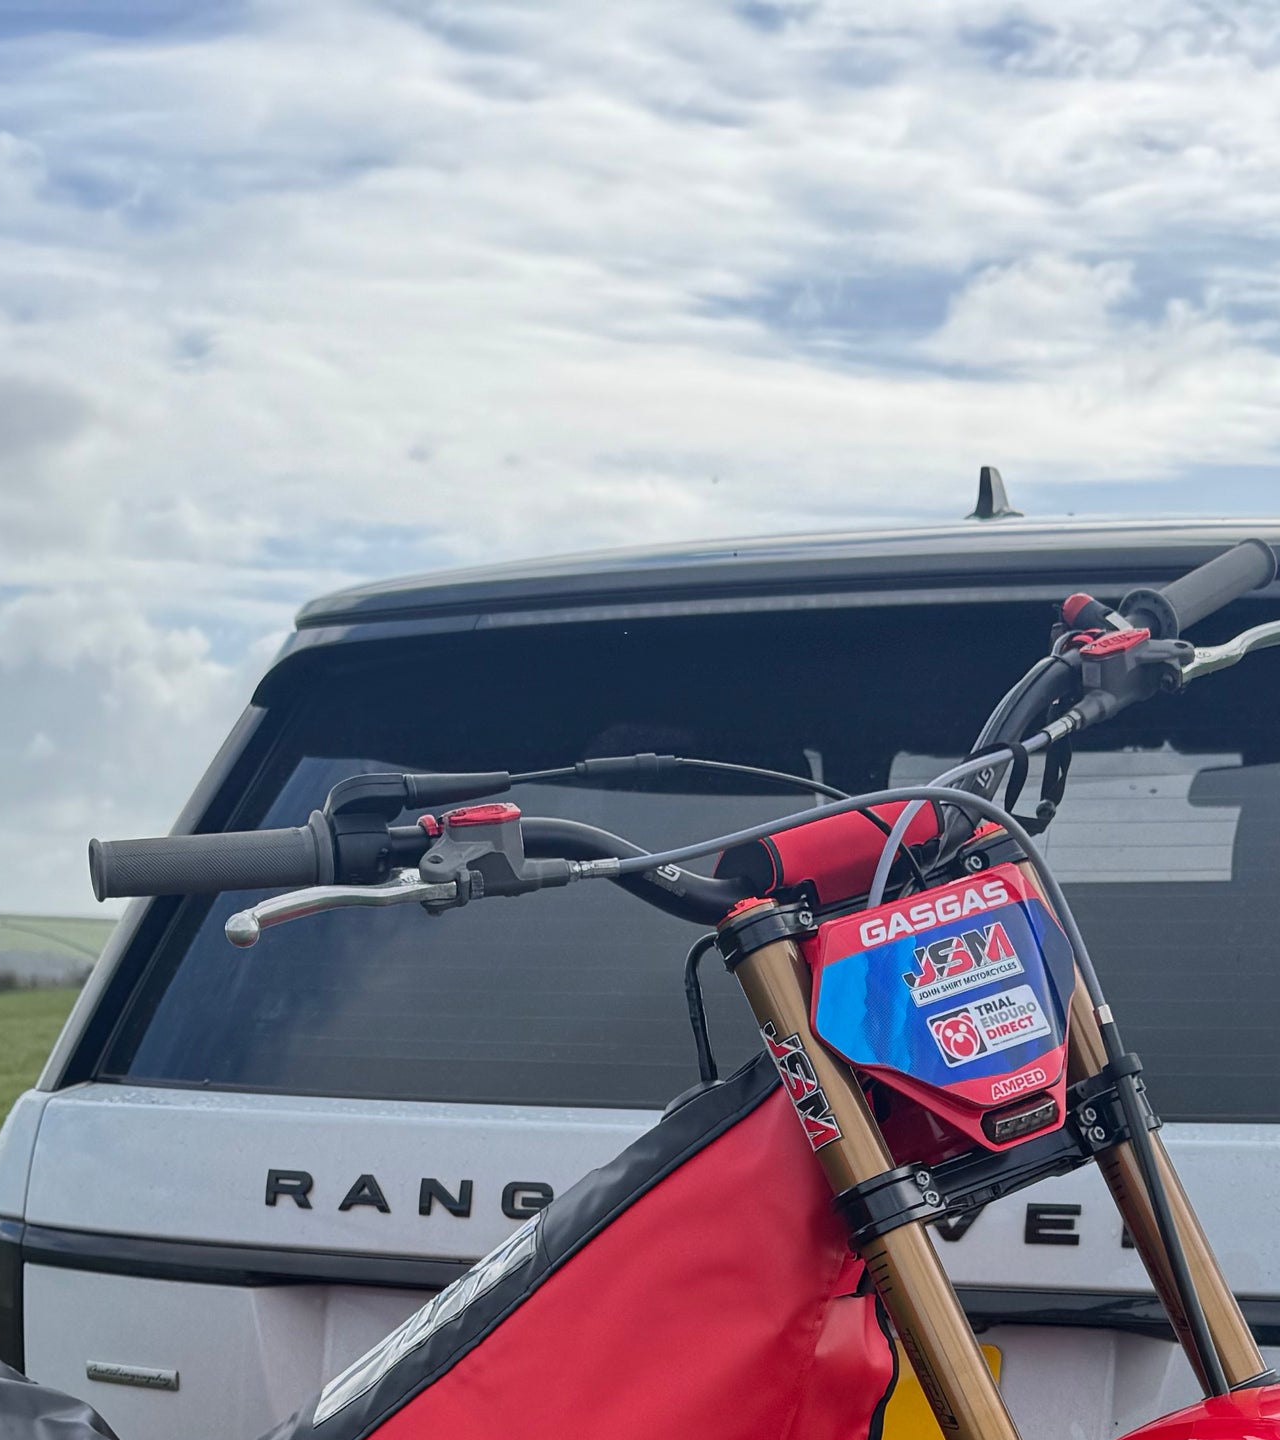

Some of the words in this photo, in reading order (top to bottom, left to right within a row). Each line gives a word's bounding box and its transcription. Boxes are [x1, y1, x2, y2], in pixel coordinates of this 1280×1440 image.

[859, 880, 1009, 948] GASGAS
[902, 921, 1016, 988] JSM
[918, 987, 941, 1001] JOHN
[942, 979, 963, 993] SHIRT
[964, 961, 1018, 986] MOTORCYCLES
[974, 996, 1017, 1017] TRIAL
[979, 1001, 1038, 1029] ENDURO
[986, 1015, 1035, 1041] DIRECT
[760, 1020, 843, 1152] JSM
[991, 1067, 1046, 1101] AMPED
[265, 1168, 554, 1220] RANG
[932, 1202, 1135, 1249] VE
